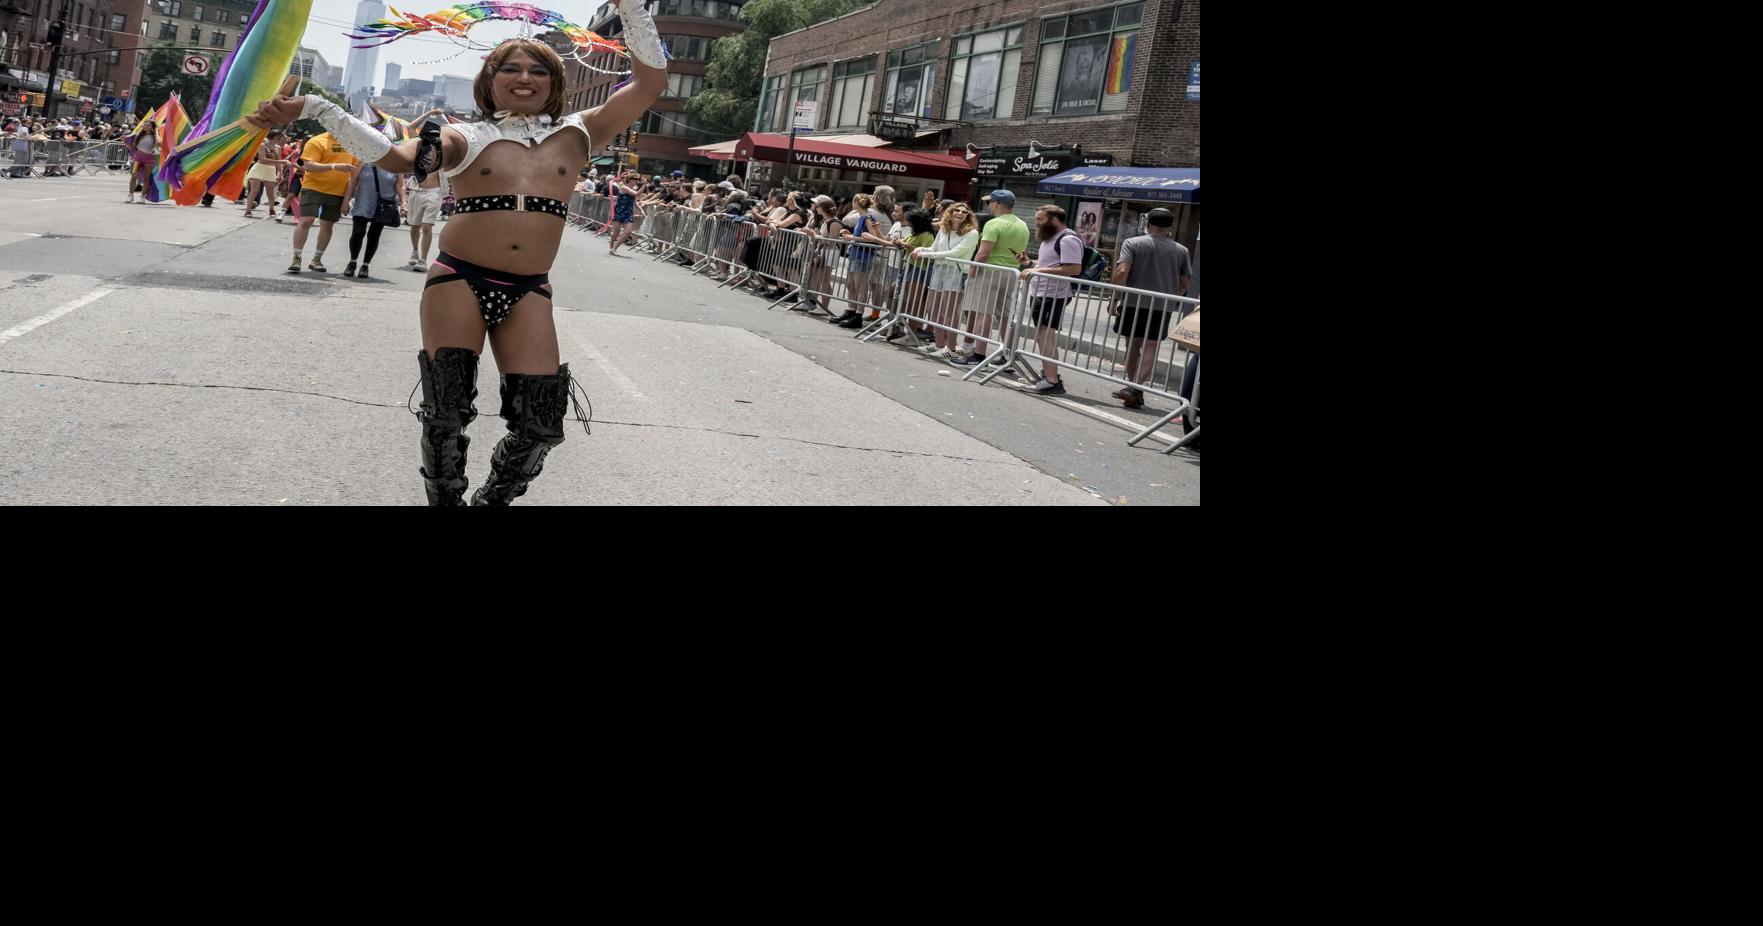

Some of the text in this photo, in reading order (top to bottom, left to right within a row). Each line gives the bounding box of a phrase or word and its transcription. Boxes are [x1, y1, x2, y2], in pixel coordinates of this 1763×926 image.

[795, 152, 907, 173] VILLAGE VANGUARD
[1012, 156, 1060, 173] Spa Jolie
